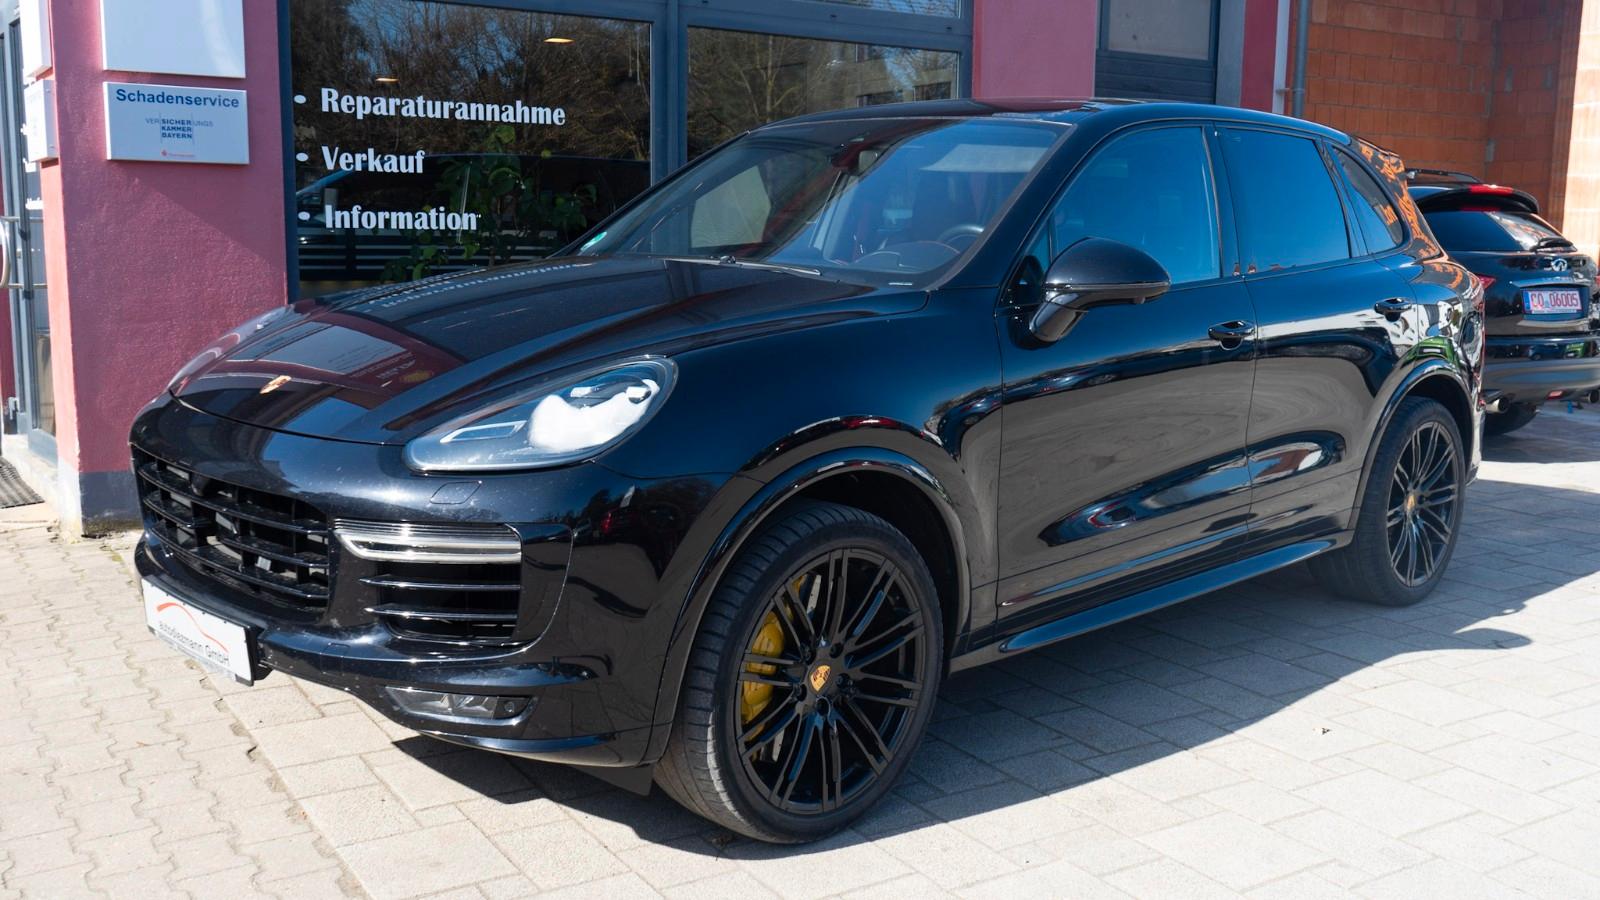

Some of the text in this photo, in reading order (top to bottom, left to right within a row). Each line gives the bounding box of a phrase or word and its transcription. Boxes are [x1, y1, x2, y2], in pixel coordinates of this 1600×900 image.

[116, 89, 239, 108] Schadenservice
[321, 87, 566, 126] Reparaturannahme
[321, 145, 425, 173] Verkauf
[325, 204, 477, 231] Information
[1549, 292, 1579, 307] 06005
